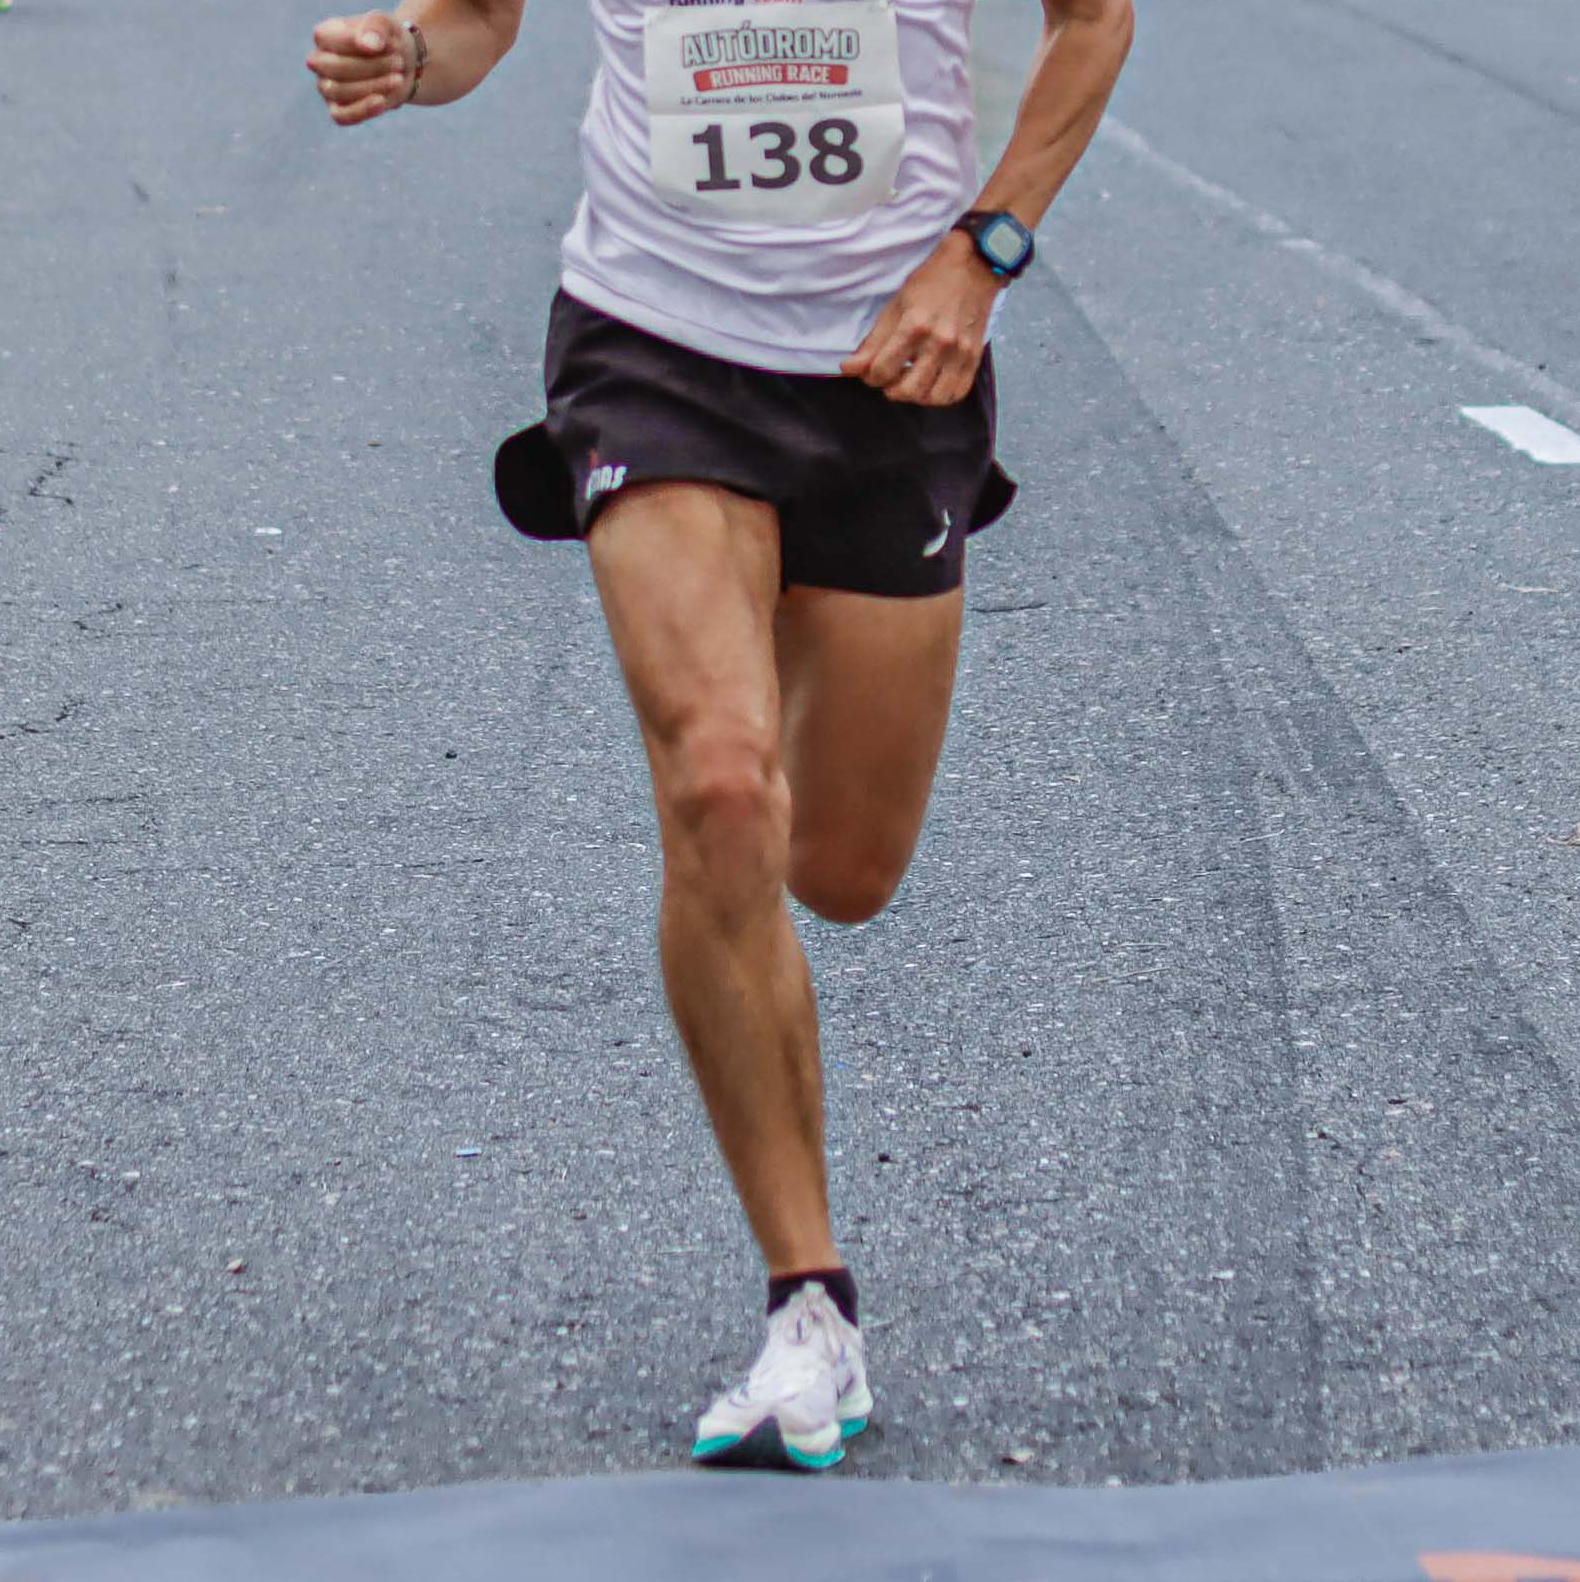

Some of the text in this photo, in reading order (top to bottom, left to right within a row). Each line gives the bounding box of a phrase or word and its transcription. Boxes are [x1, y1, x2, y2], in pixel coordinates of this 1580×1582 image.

[682, 20, 860, 68] AUTÓDROMO
[710, 64, 831, 88] RUNNING RACE
[692, 118, 864, 192] 138
